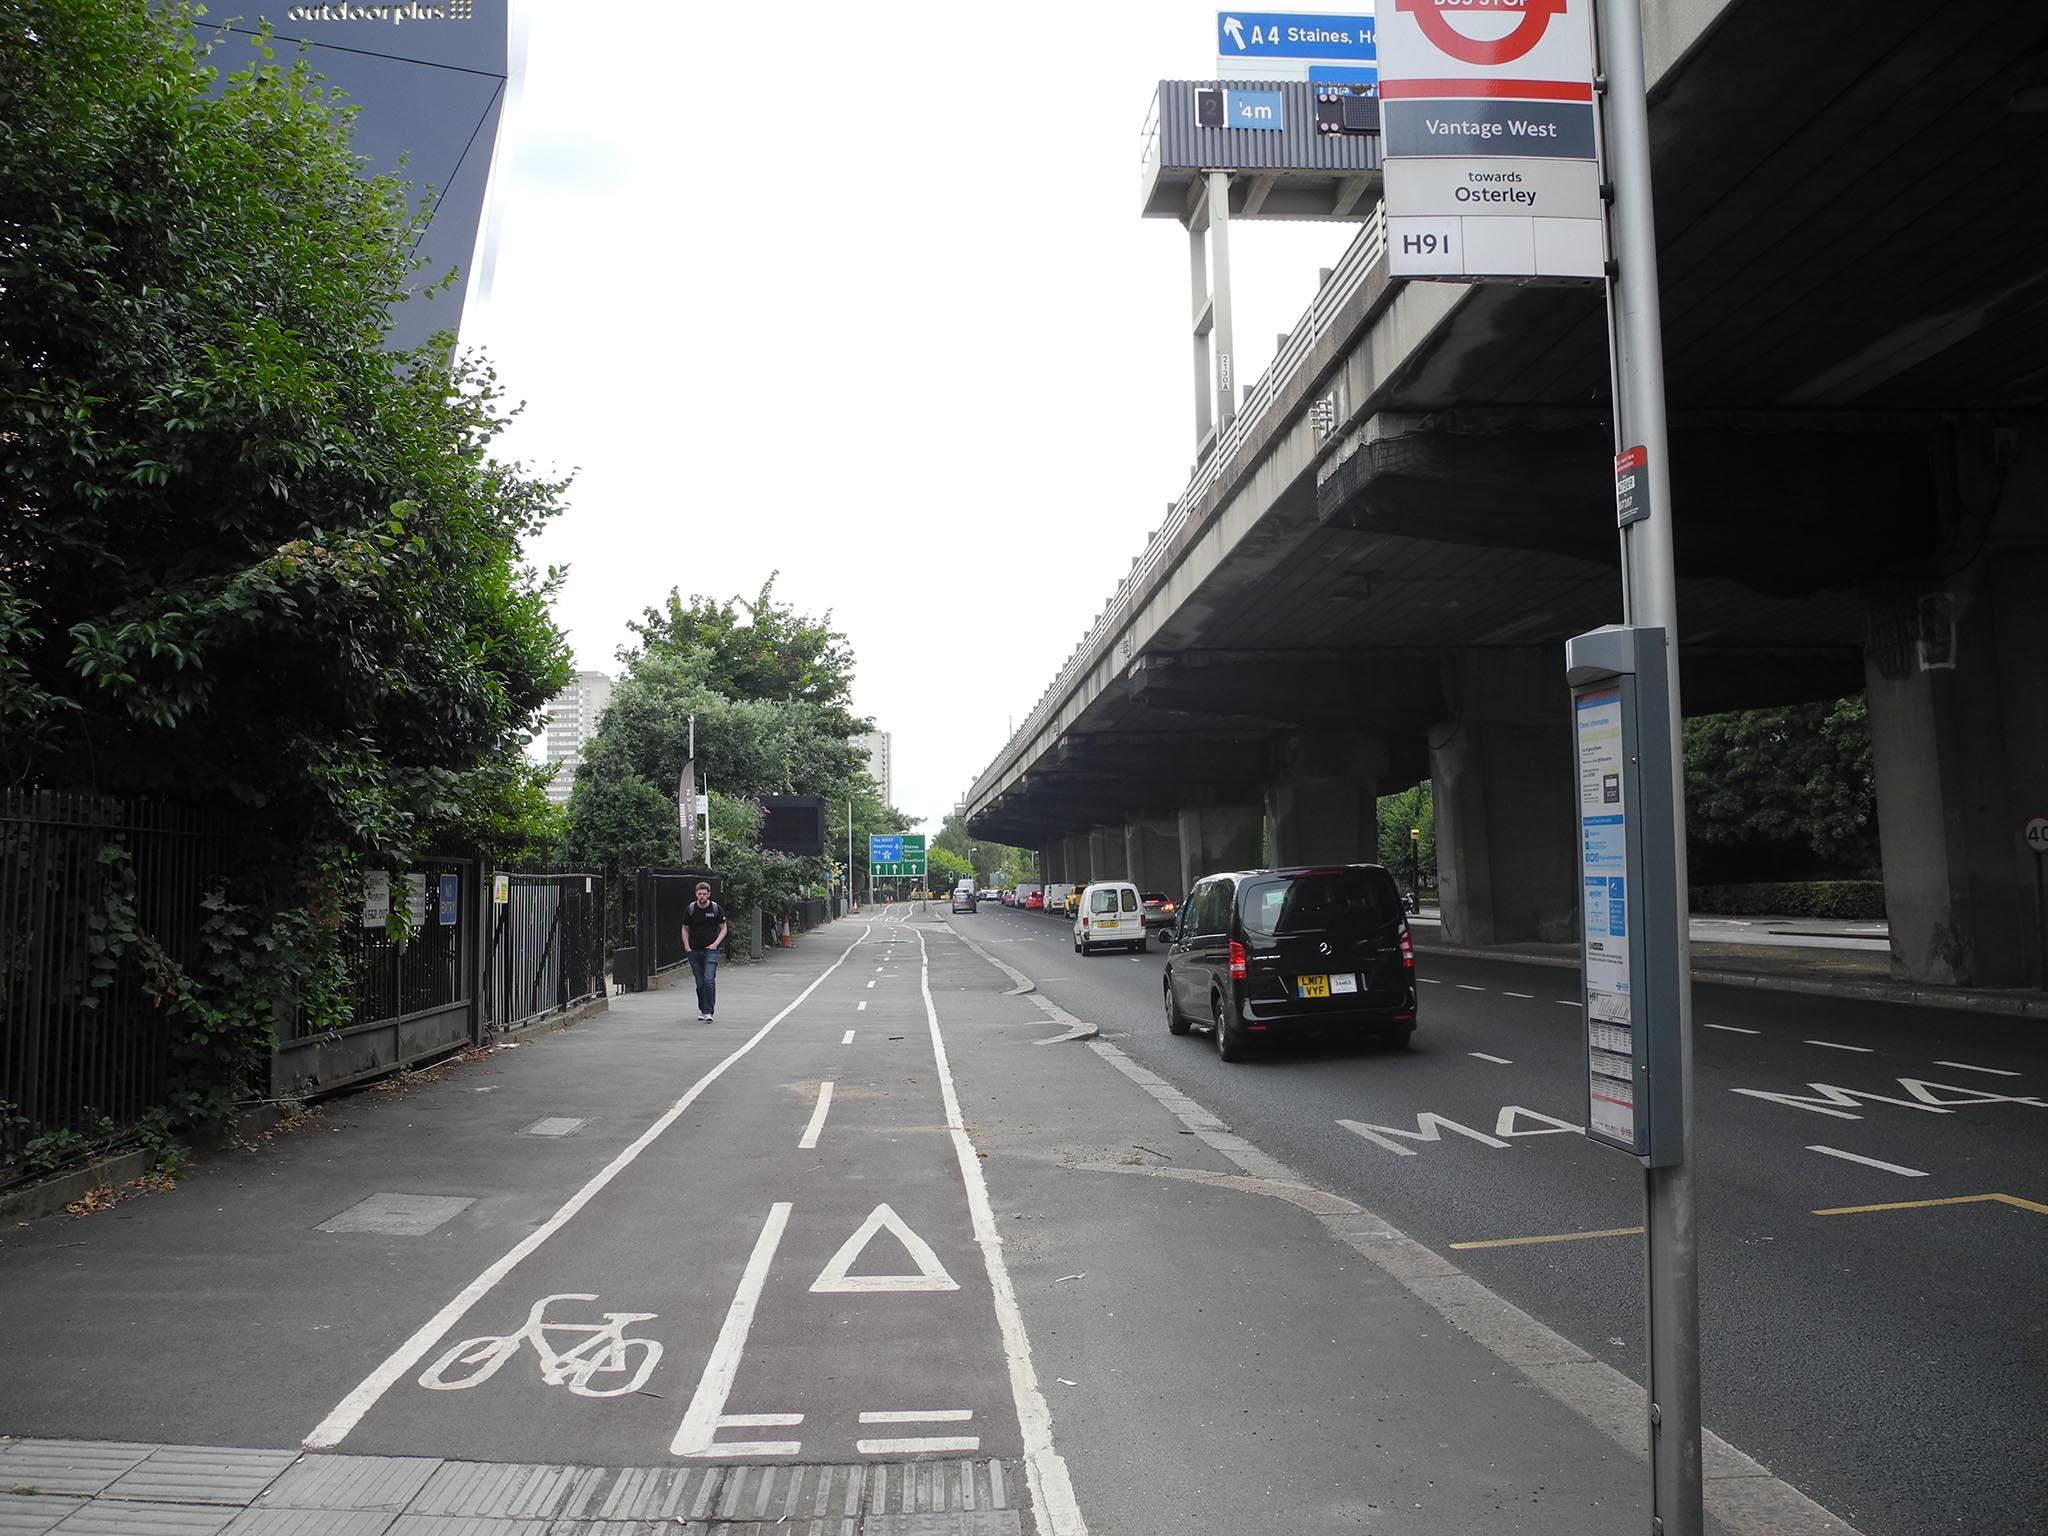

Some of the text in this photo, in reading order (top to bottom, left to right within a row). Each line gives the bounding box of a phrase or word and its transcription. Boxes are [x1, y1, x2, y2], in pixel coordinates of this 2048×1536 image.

[1287, 27, 1352, 44] Staines,
[1425, 120, 1557, 138] Vantage West
[1468, 171, 1522, 183] towards
[1455, 186, 1536, 206] Osterley
[1403, 233, 1449, 254] H91
[1306, 985, 1325, 996] VYF
[1729, 1078, 2048, 1120] M4
[1334, 1106, 1585, 1156] M4
